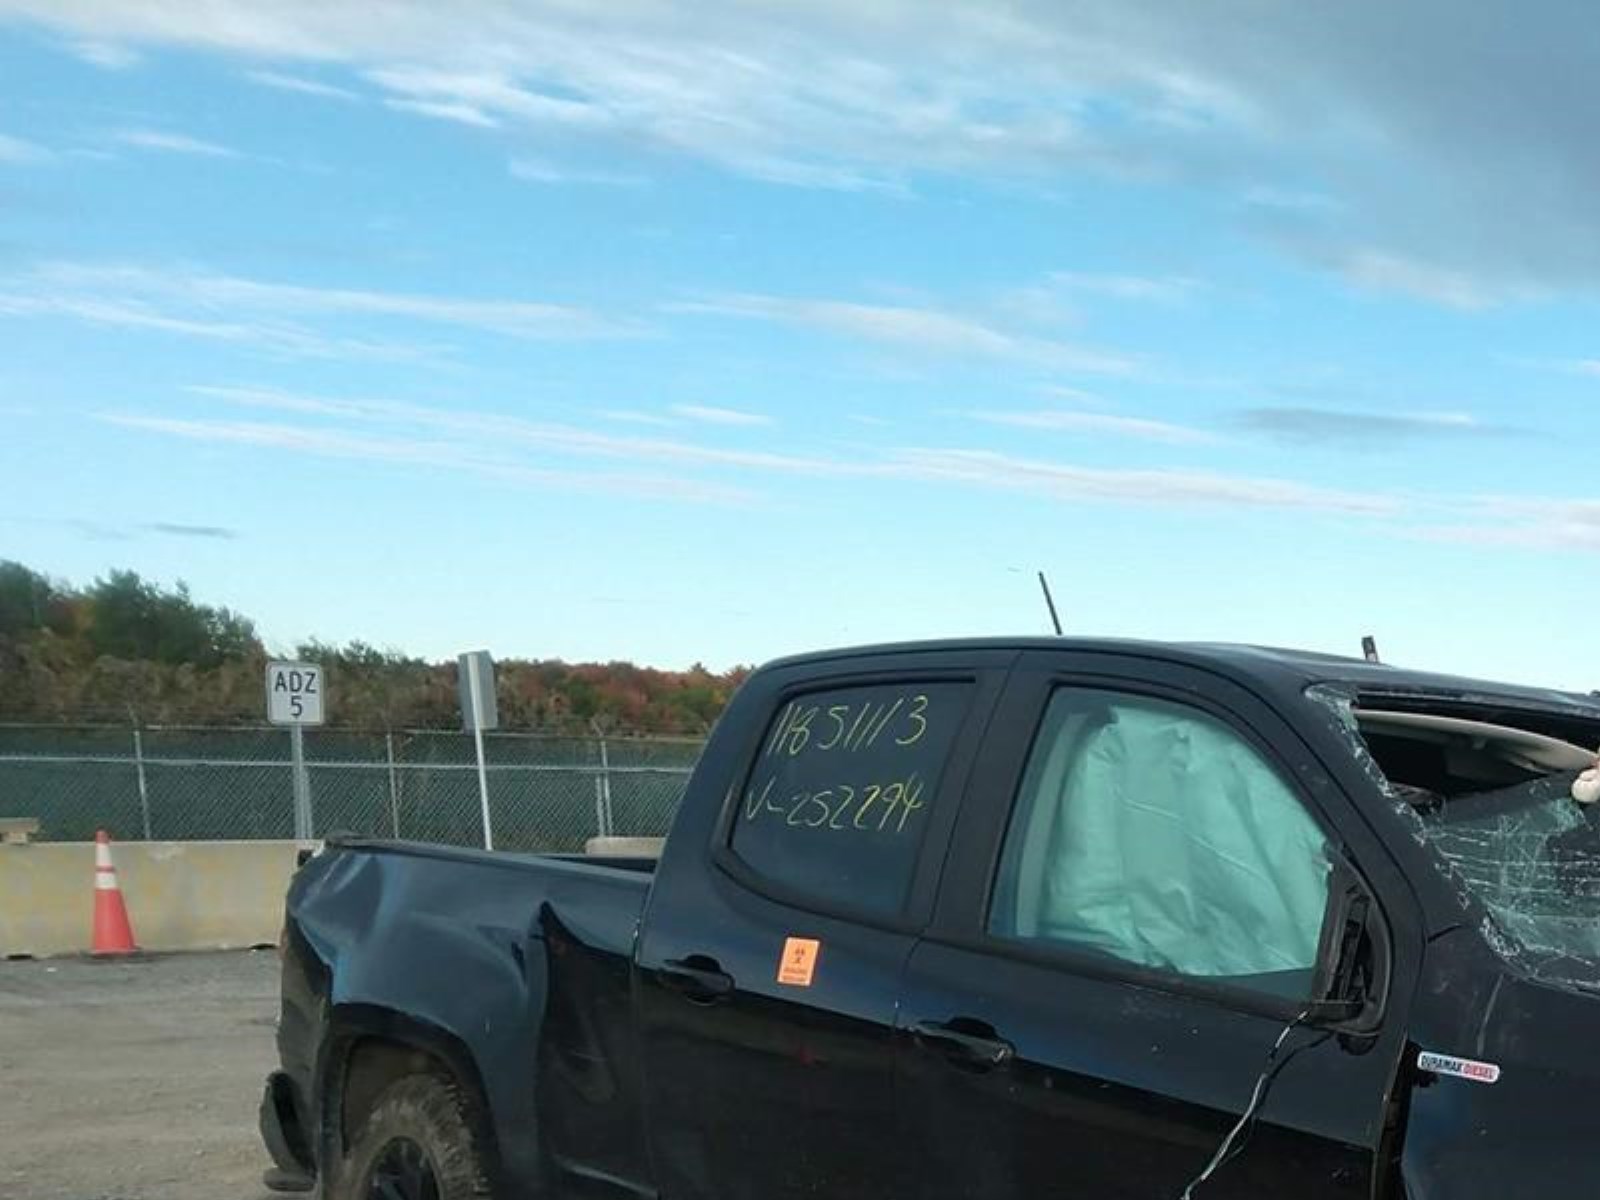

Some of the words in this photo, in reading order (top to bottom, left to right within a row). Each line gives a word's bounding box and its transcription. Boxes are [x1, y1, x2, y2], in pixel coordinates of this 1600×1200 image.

[275, 671, 316, 693] ADZ
[291, 695, 302, 718] 5
[1420, 1054, 1462, 1074] DURAMAX
[1462, 1062, 1496, 1080] DIESEL
